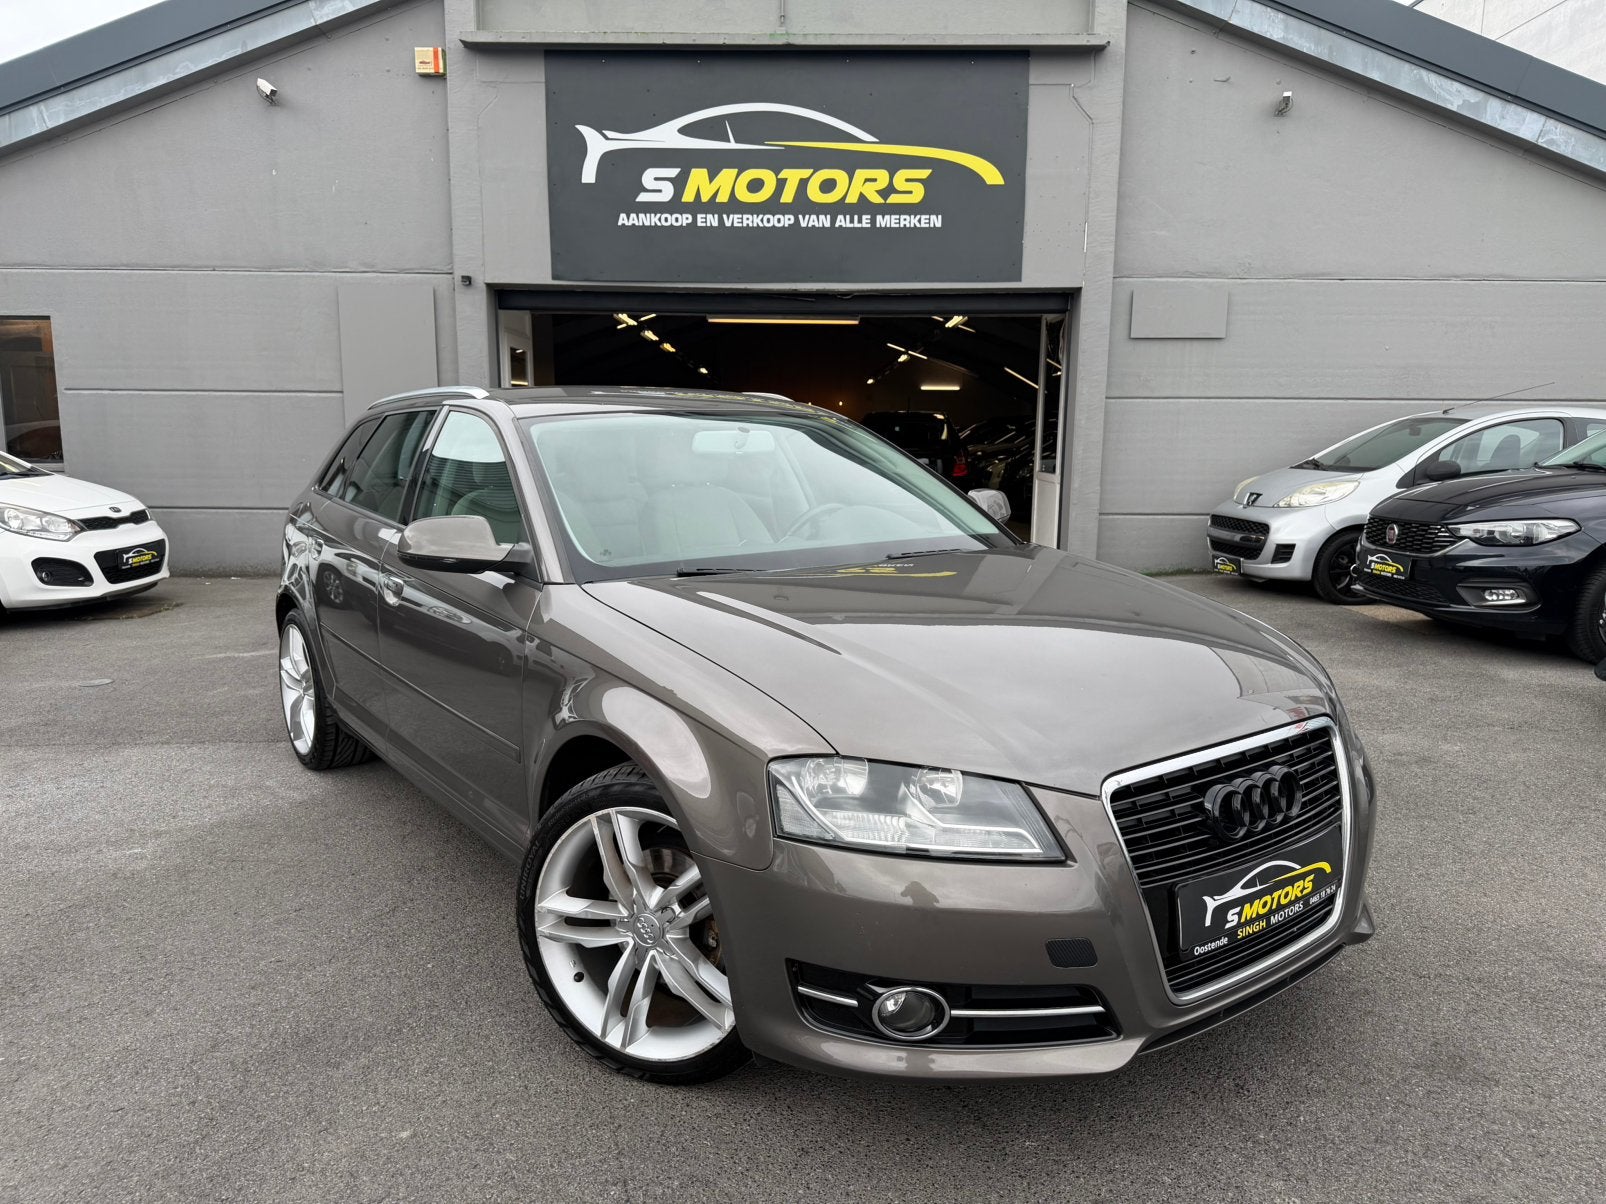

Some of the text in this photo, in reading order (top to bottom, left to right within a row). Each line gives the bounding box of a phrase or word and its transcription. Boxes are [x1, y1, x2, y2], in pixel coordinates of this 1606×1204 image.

[635, 168, 932, 204] S MOTORS
[617, 213, 942, 228] AANKOOP EN VERKOOP VAN ALLE MERKEN
[1375, 563, 1397, 574] MOTORS
[1224, 873, 1315, 929] S MOTORS
[1194, 936, 1228, 955] Oostende
[1237, 919, 1266, 939] SINGH
[1270, 900, 1304, 925] MOTORS
